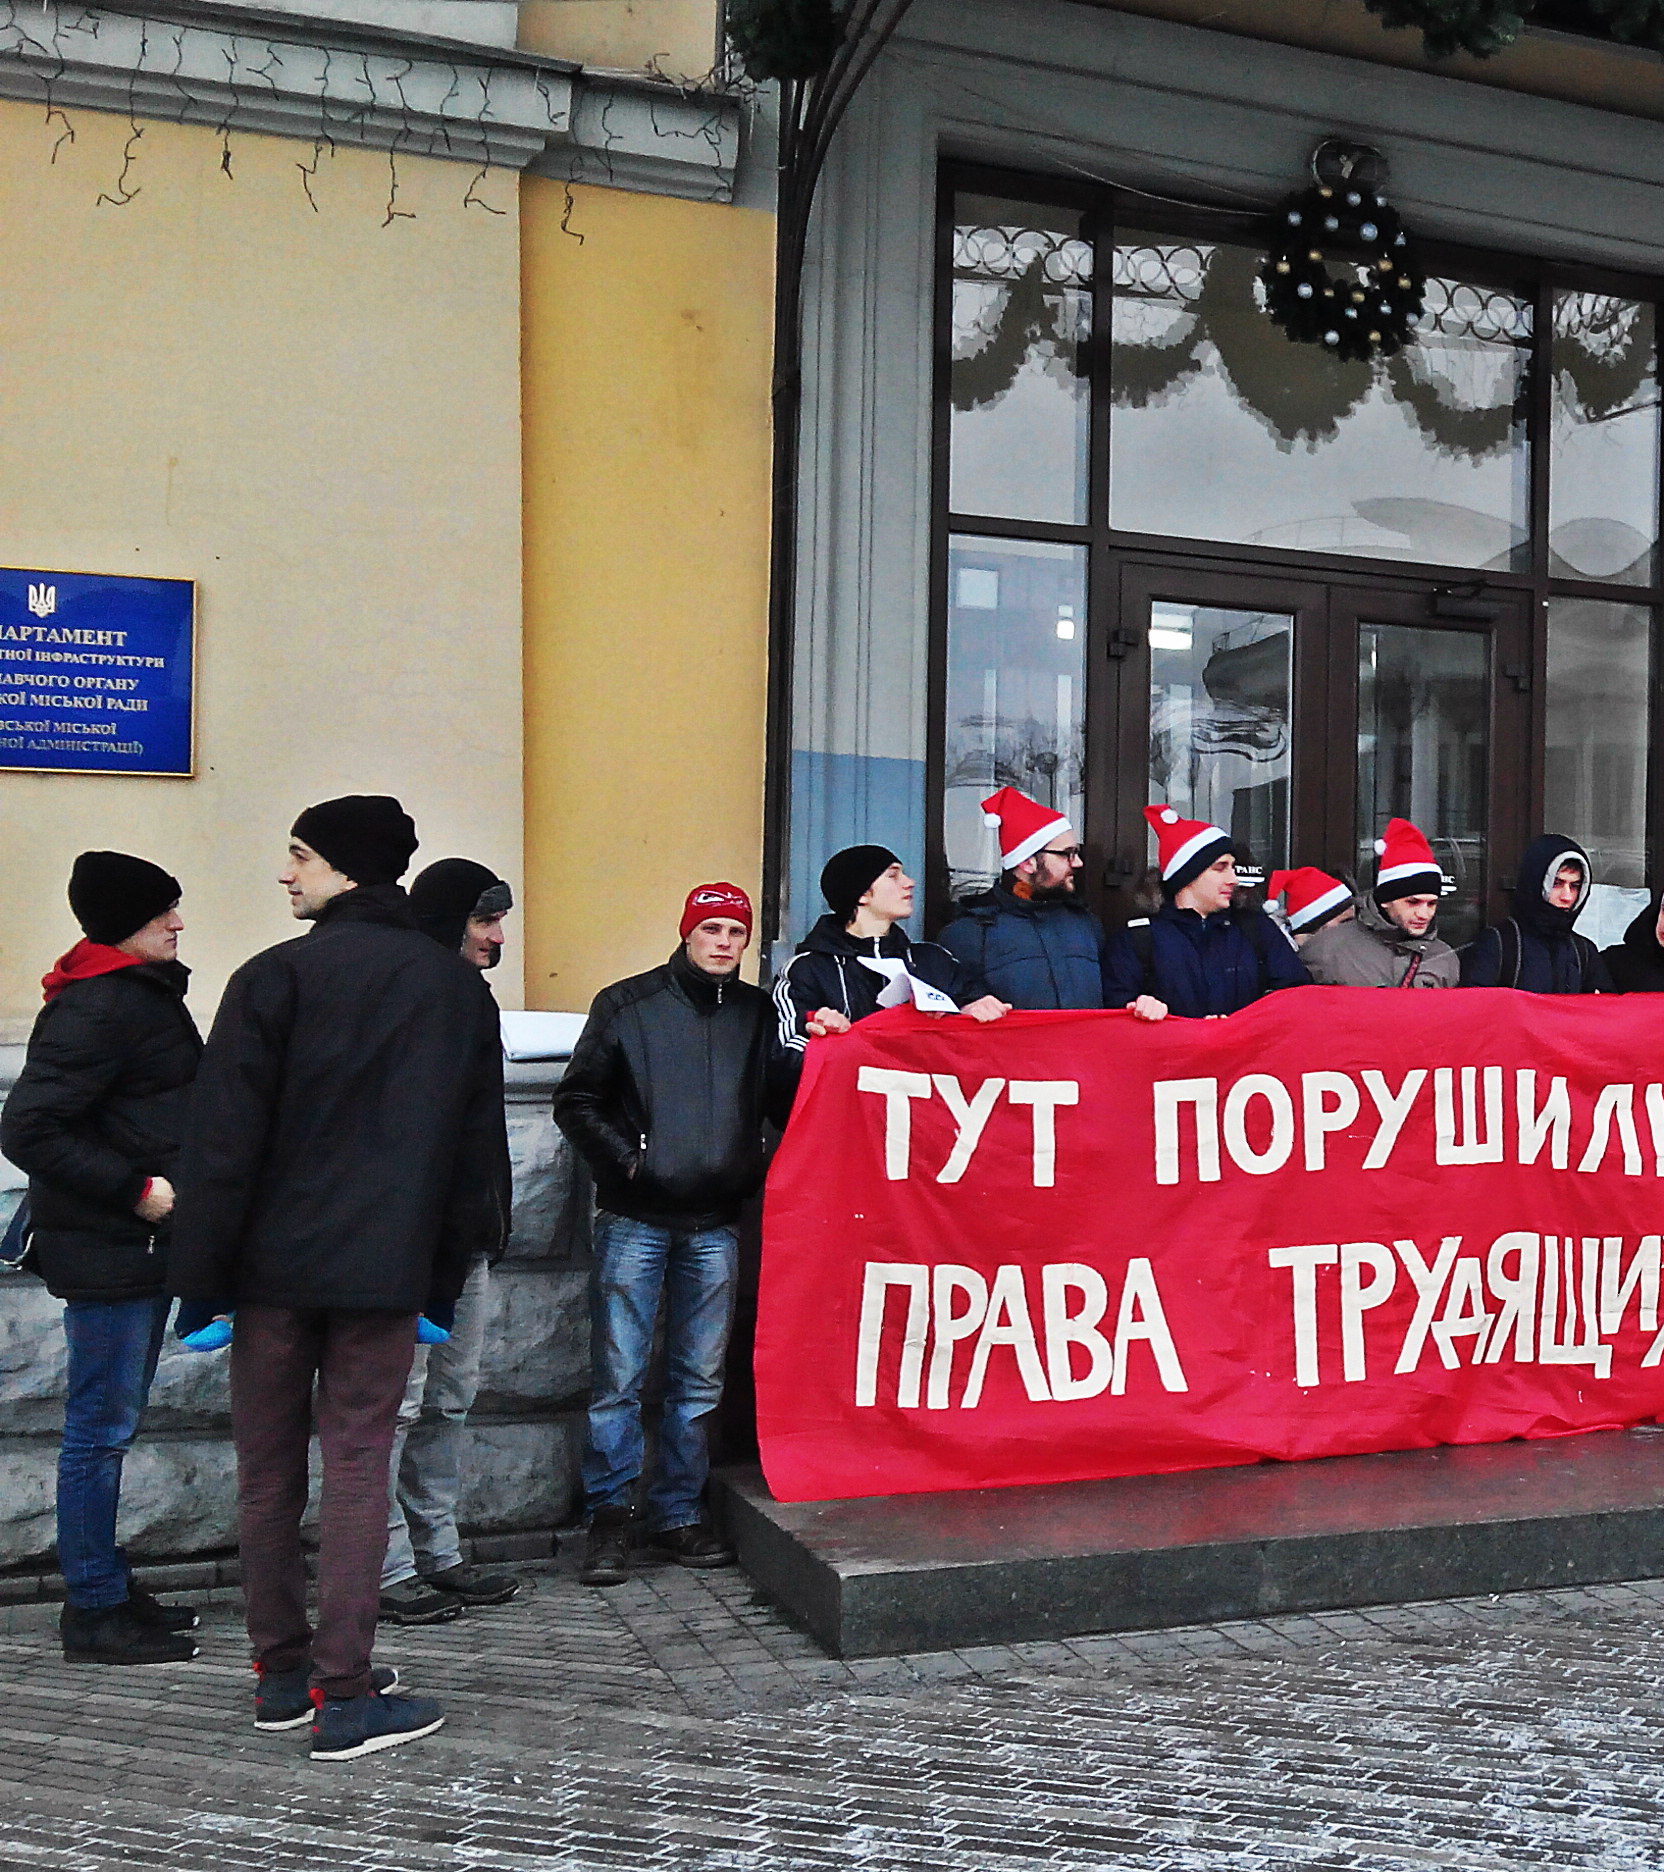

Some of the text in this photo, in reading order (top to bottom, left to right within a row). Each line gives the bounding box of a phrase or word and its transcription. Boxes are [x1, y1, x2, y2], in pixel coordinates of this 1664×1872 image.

[0, 624, 128, 647] АРТАМЕНТ
[35, 651, 165, 668] ІНФРАСТРУКТУРИ
[0, 672, 139, 691] АВЧОГО ОРГАНУ
[30, 694, 103, 709] МІСЬКОЇ
[107, 697, 149, 712] РАДИ
[53, 722, 117, 735] МІСЬКОЇ
[857, 1065, 1080, 1187] ТУТ
[855, 1256, 1188, 1410] ПРАВА
